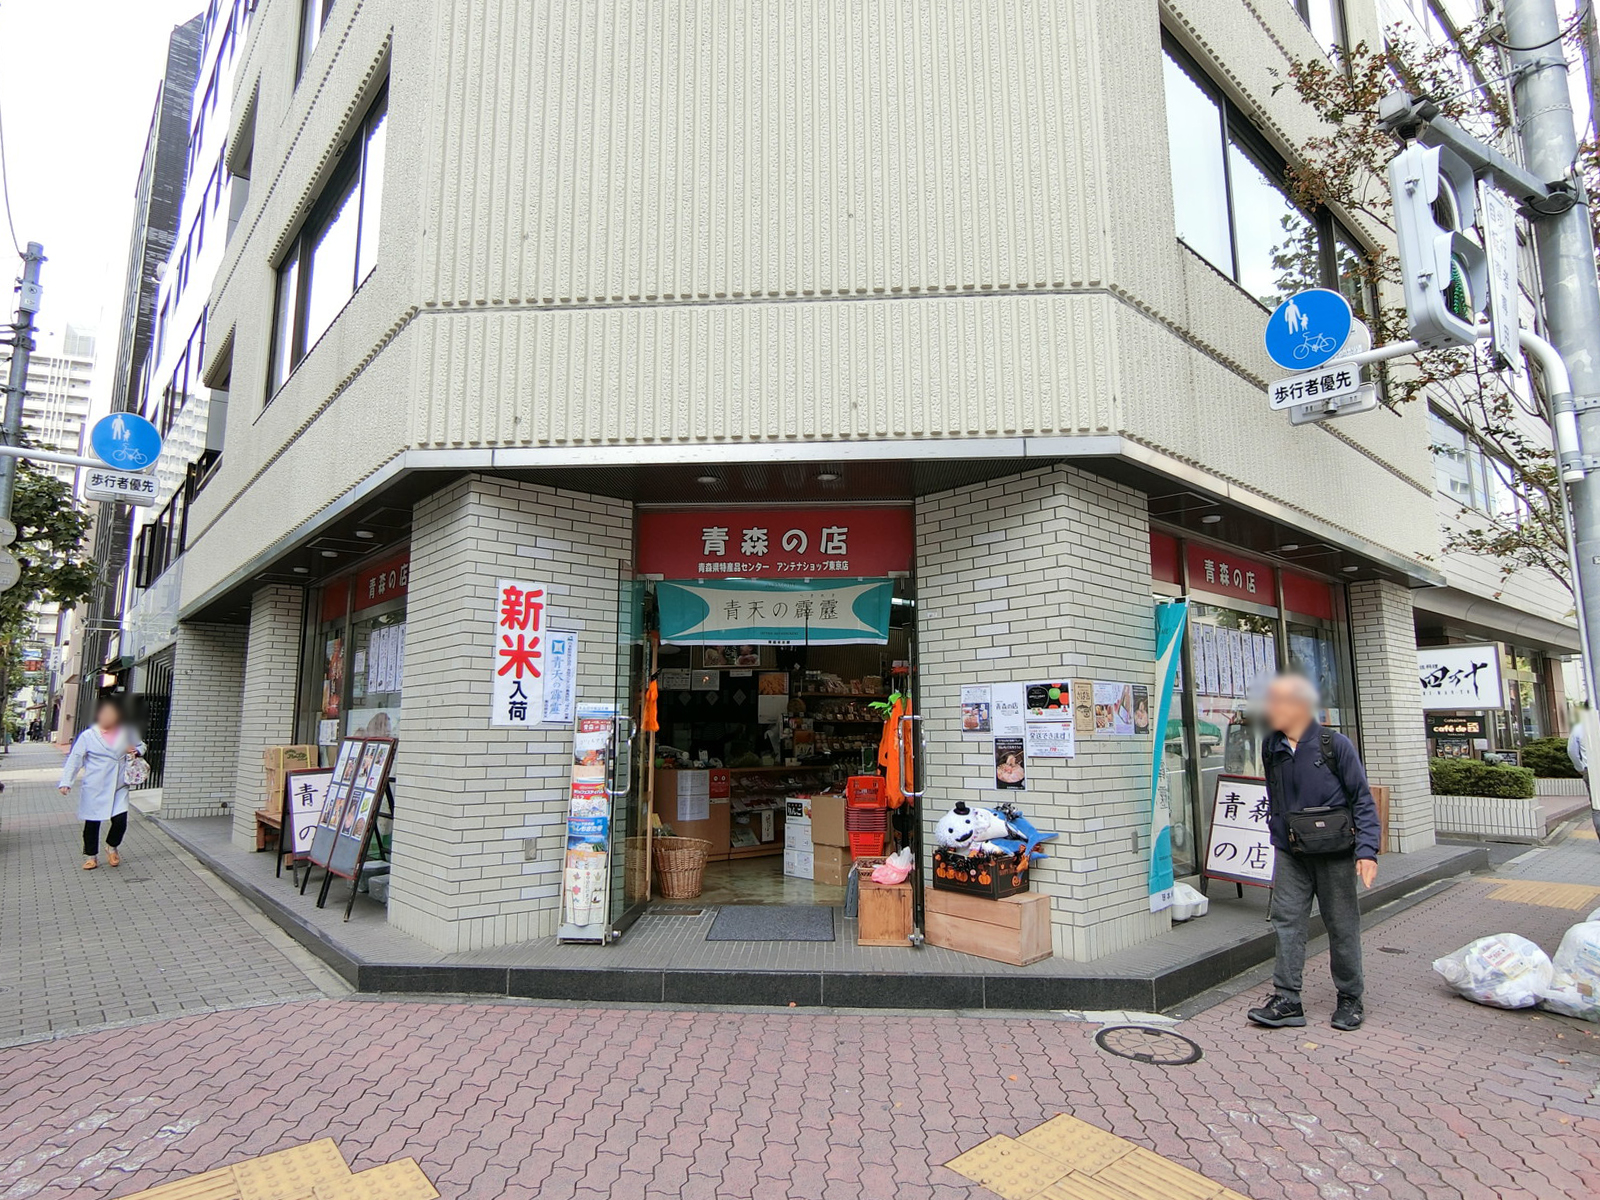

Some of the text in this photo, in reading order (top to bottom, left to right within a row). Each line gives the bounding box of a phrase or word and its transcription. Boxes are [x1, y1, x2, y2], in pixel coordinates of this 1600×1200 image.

[1275, 371, 1352, 404] 歩行者優先
[91, 473, 155, 493] 歩行者優先
[701, 526, 849, 557] 青森の店
[368, 563, 409, 599] 青森の店
[698, 560, 849, 573] 青森県特産品センター アンテナショップ東京店
[1204, 559, 1257, 594] 青森の店
[723, 599, 840, 621] 青天の霹靂
[1219, 792, 1272, 825] 青森
[1214, 842, 1270, 870] の店
